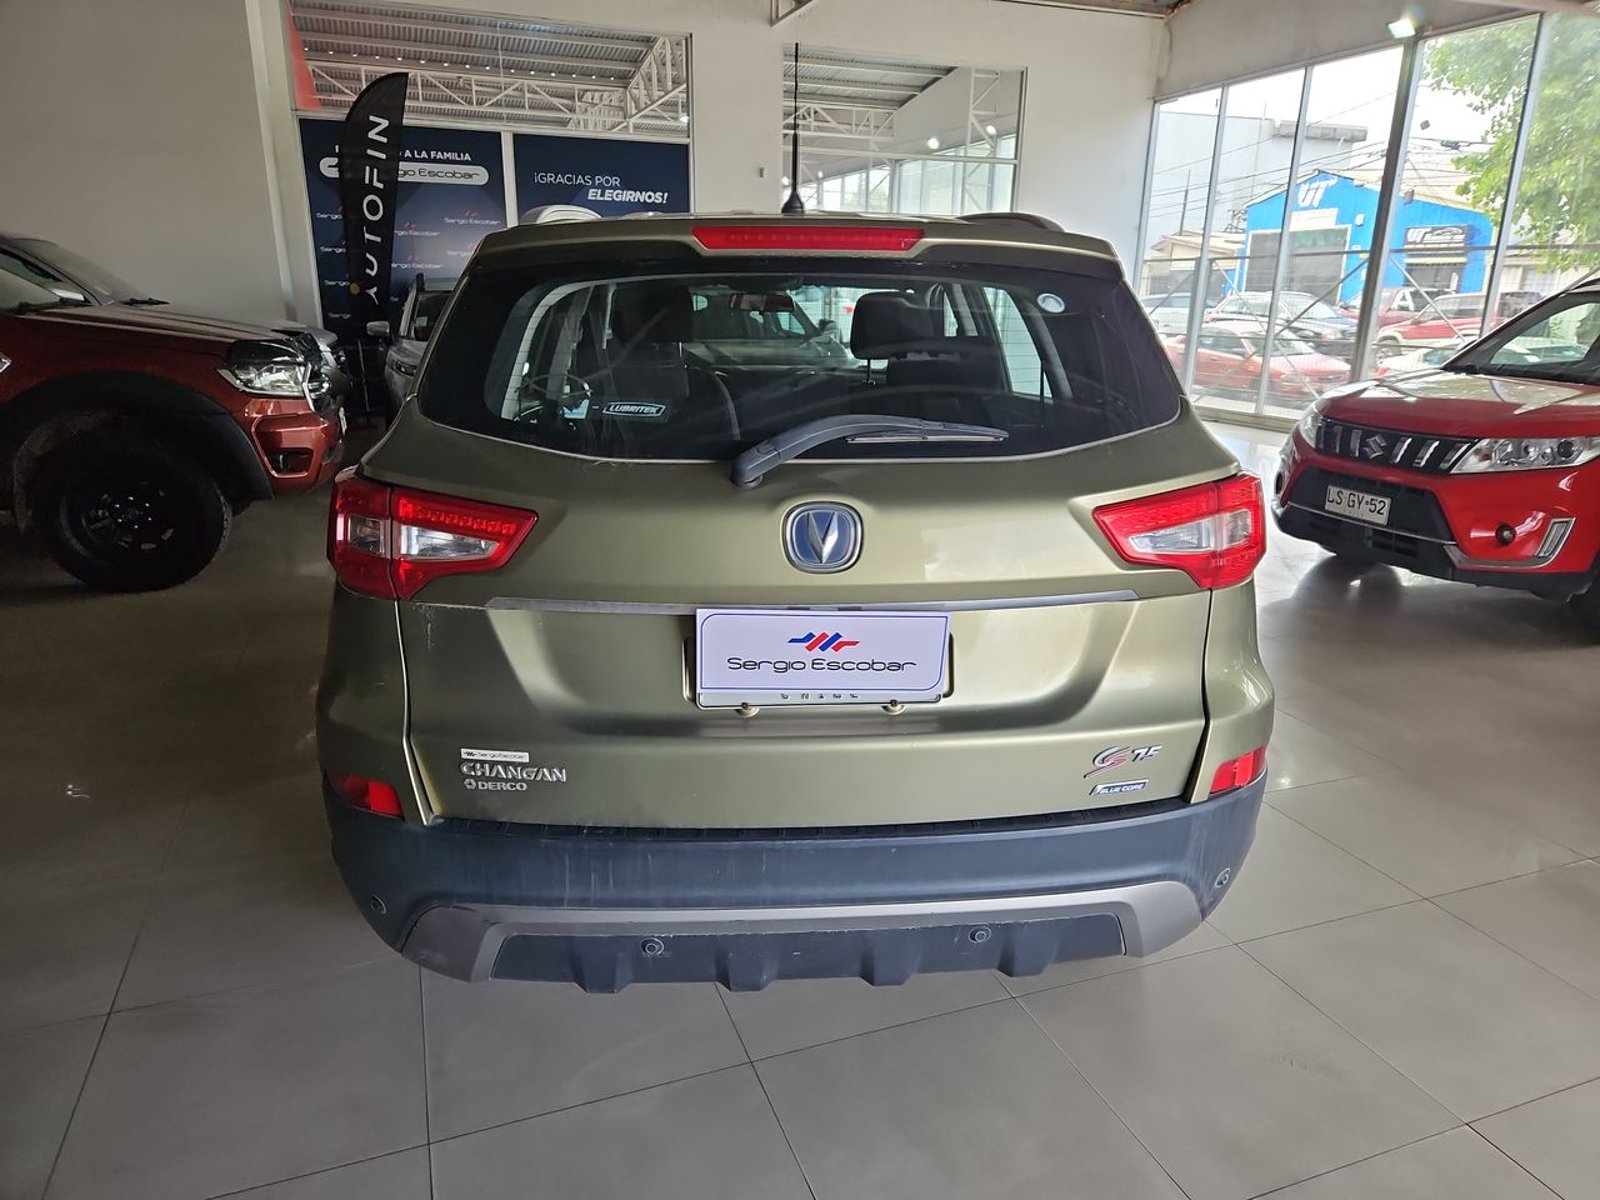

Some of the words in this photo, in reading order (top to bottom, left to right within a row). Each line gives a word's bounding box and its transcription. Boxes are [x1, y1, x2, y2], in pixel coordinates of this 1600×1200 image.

[405, 150, 412, 159] A
[414, 150, 428, 160] LA
[431, 151, 471, 161] FAMILIA
[418, 168, 479, 180] Escobar
[534, 172, 592, 186] ¡GRACIAS
[595, 176, 621, 187] POR
[588, 188, 668, 204] ELEGIRNOS!
[362, 115, 389, 305] AUTOFIN
[609, 404, 659, 413] LUBRITEK
[727, 657, 806, 673] Sergio
[811, 658, 917, 672] Escobar
[460, 762, 566, 782] CHANGAN
[478, 781, 528, 791] DERCO
